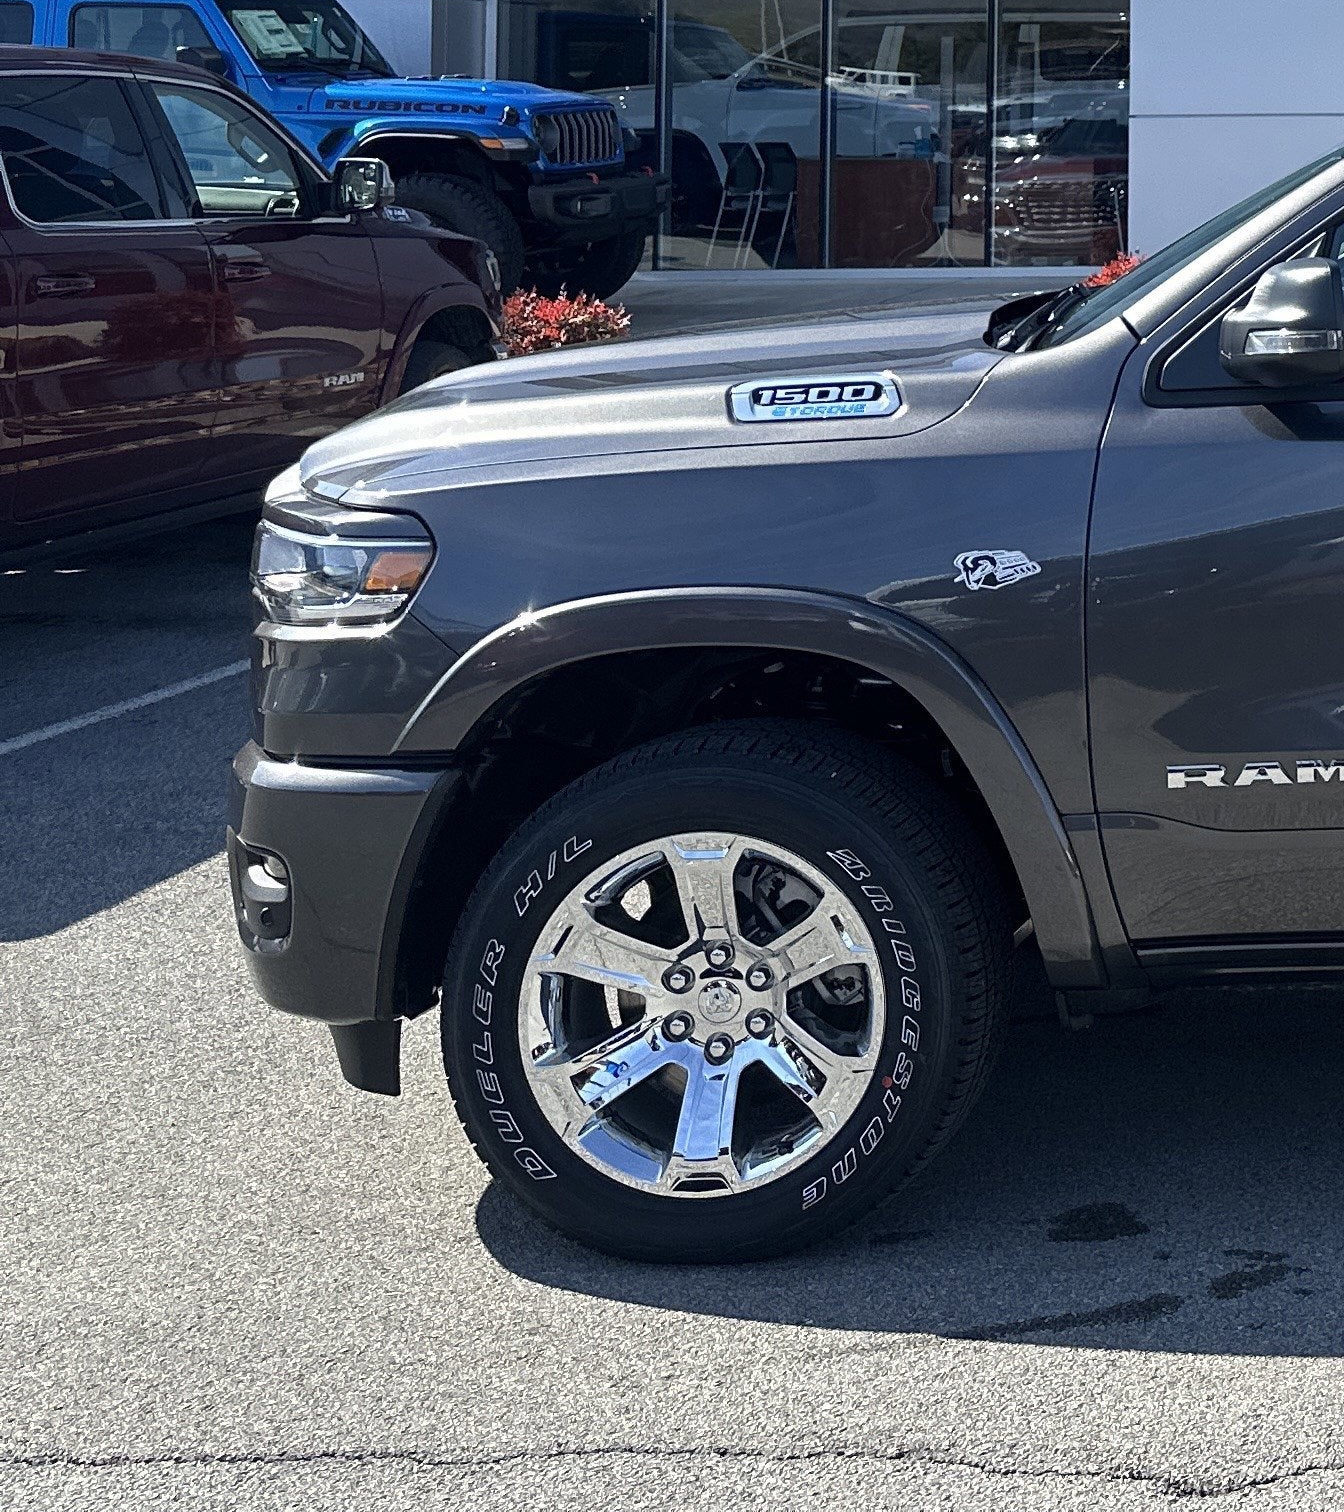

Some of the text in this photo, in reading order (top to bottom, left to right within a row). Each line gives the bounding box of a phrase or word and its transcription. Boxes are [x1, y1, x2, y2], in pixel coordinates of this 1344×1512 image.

[324, 98, 487, 115] RUBICON
[323, 371, 365, 388] RAM
[758, 384, 876, 406] 1500
[801, 847, 922, 1211] BRIDGESTONE
[471, 937, 558, 1182] DUELER
